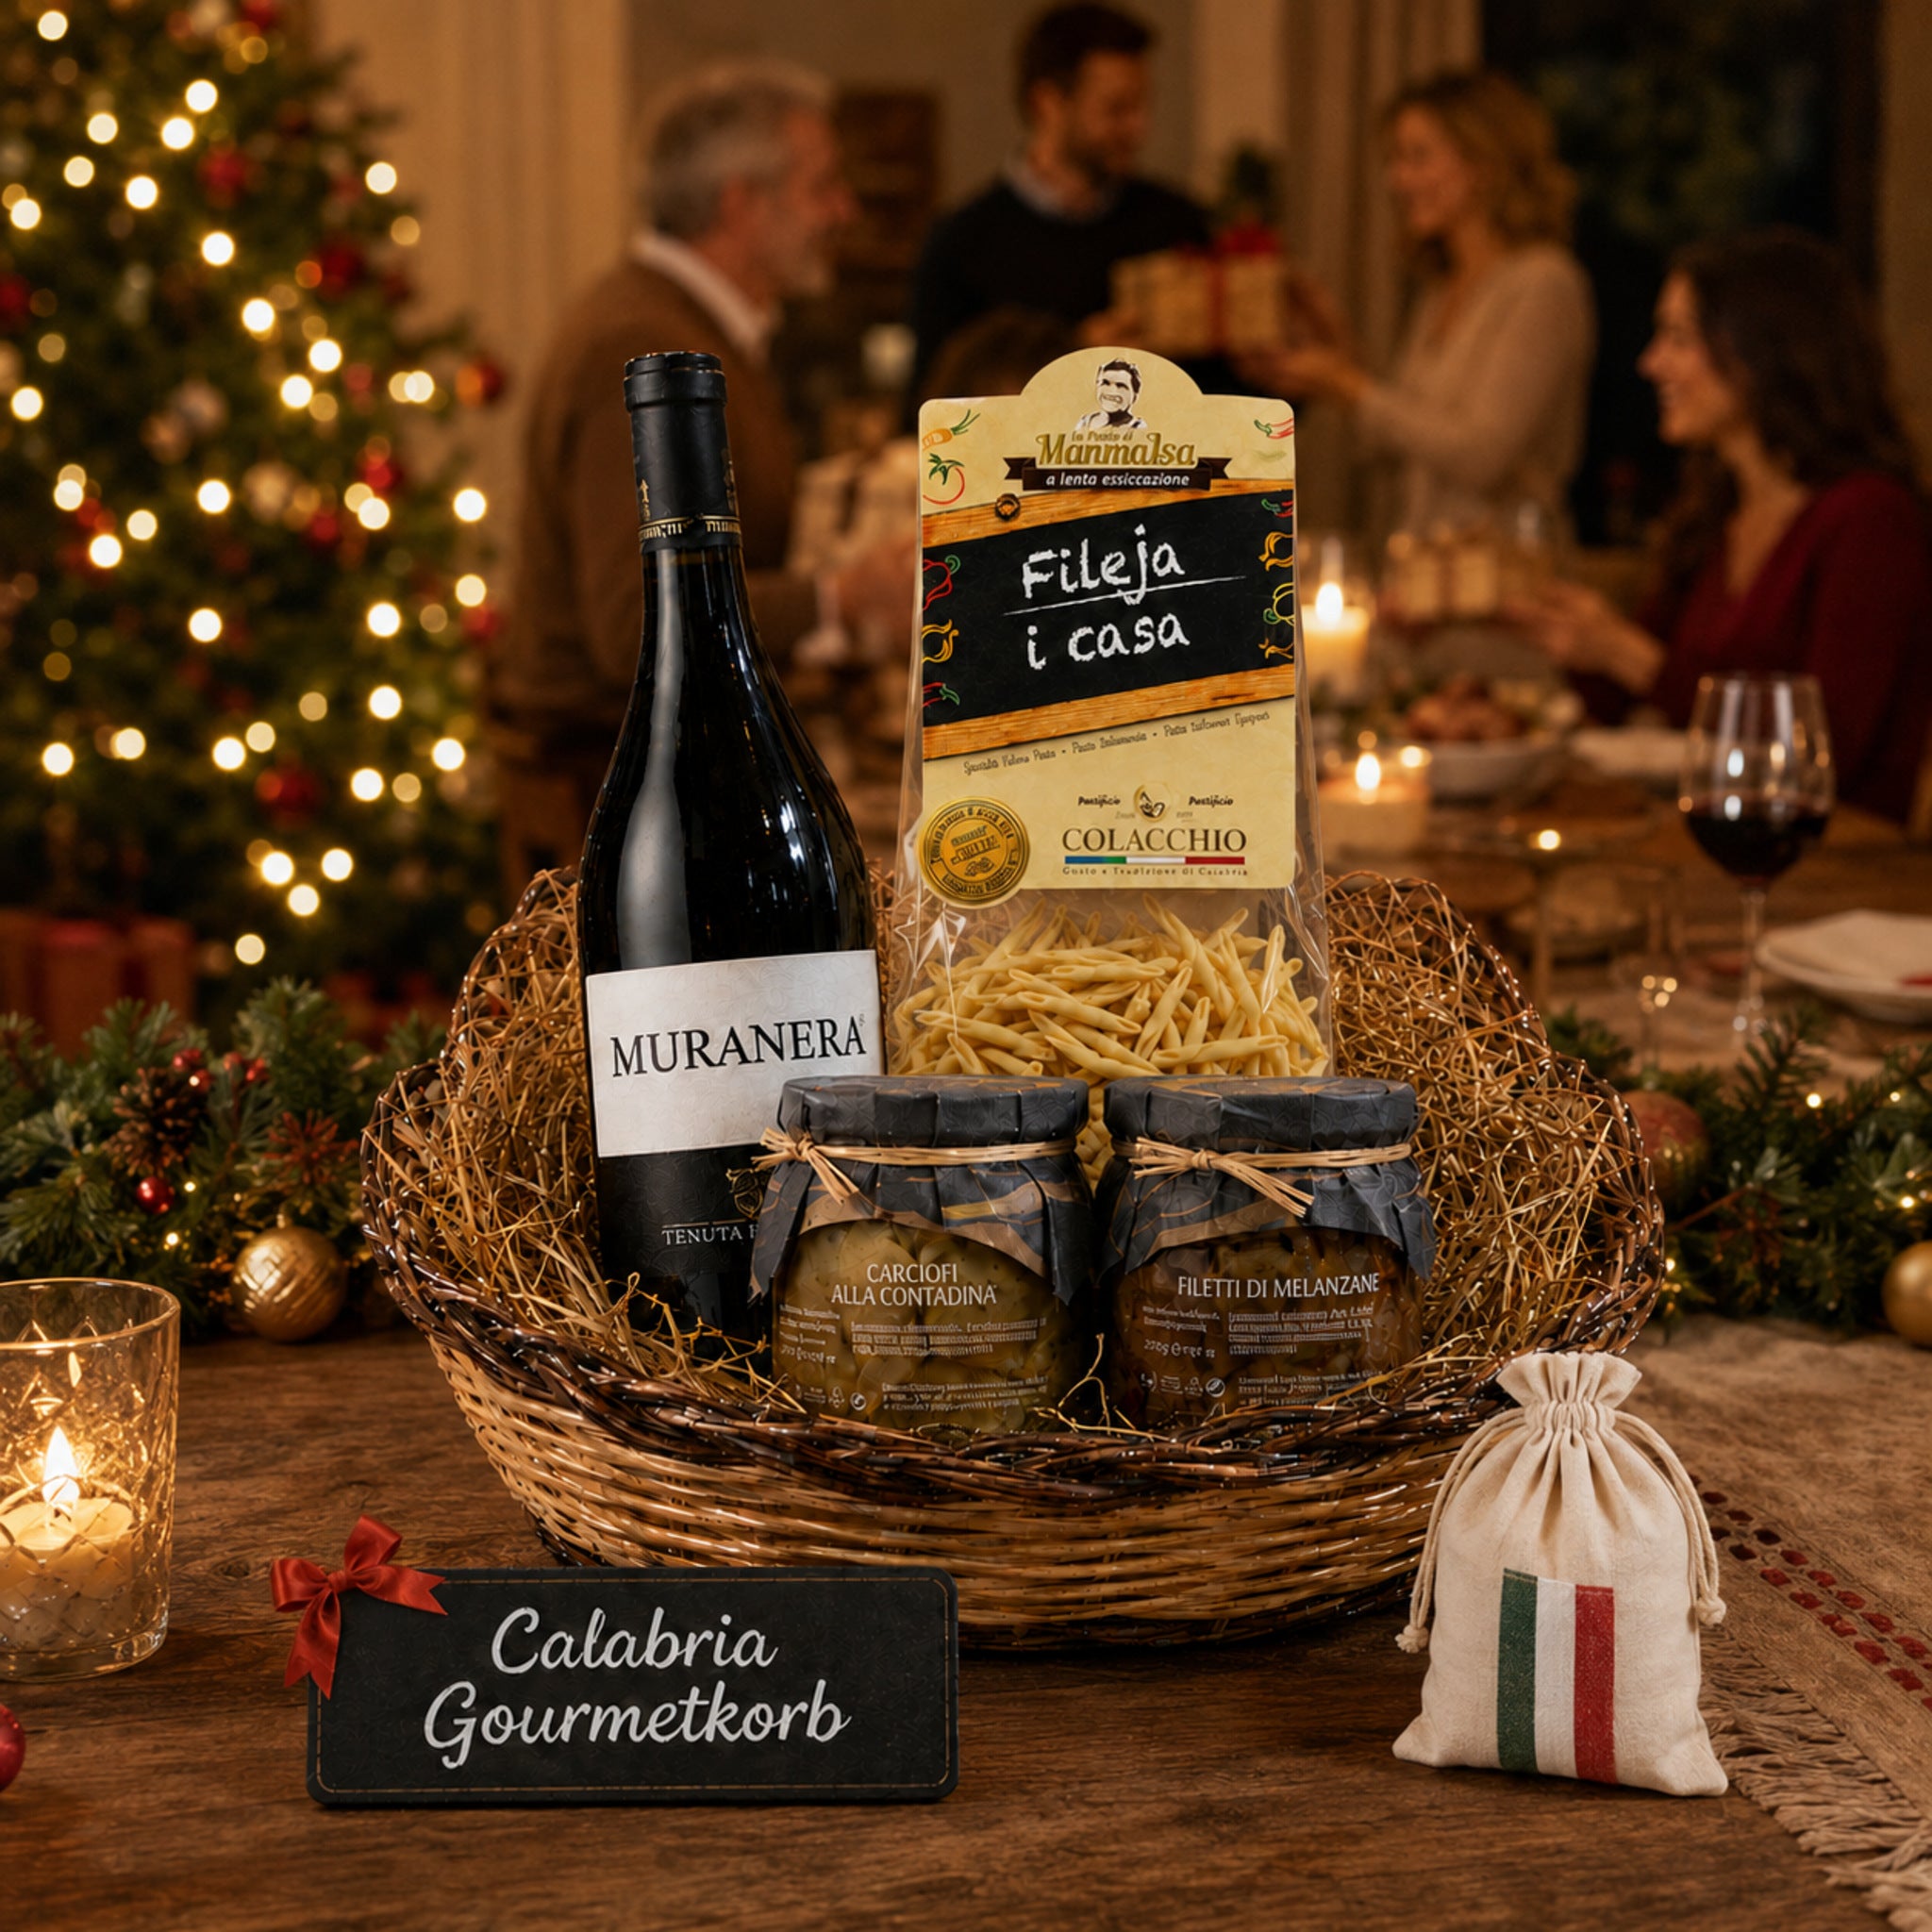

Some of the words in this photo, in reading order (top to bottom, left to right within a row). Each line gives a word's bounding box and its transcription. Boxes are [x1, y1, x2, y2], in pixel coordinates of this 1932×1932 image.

[1045, 475, 1056, 486] a
[1059, 472, 1097, 486] lenta
[1102, 473, 1190, 486] essiccazione
[1022, 524, 1185, 605] Fileja
[1026, 625, 1047, 670] i
[1067, 613, 1191, 662] casa
[1062, 827, 1247, 853] COLACCHIO
[609, 1015, 867, 1077] MURANERA
[660, 1225, 743, 1245] TENUTA
[867, 1263, 958, 1284] CARCIOFI
[1178, 1275, 1241, 1298] FILETTI
[1246, 1278, 1268, 1298] DI
[1274, 1273, 1380, 1298] MELANZANE
[831, 1284, 876, 1306] ALLA
[879, 1284, 997, 1307] CONTADINA
[491, 1606, 779, 1674] Calabria
[423, 1678, 852, 1769] Gourmetkorb
